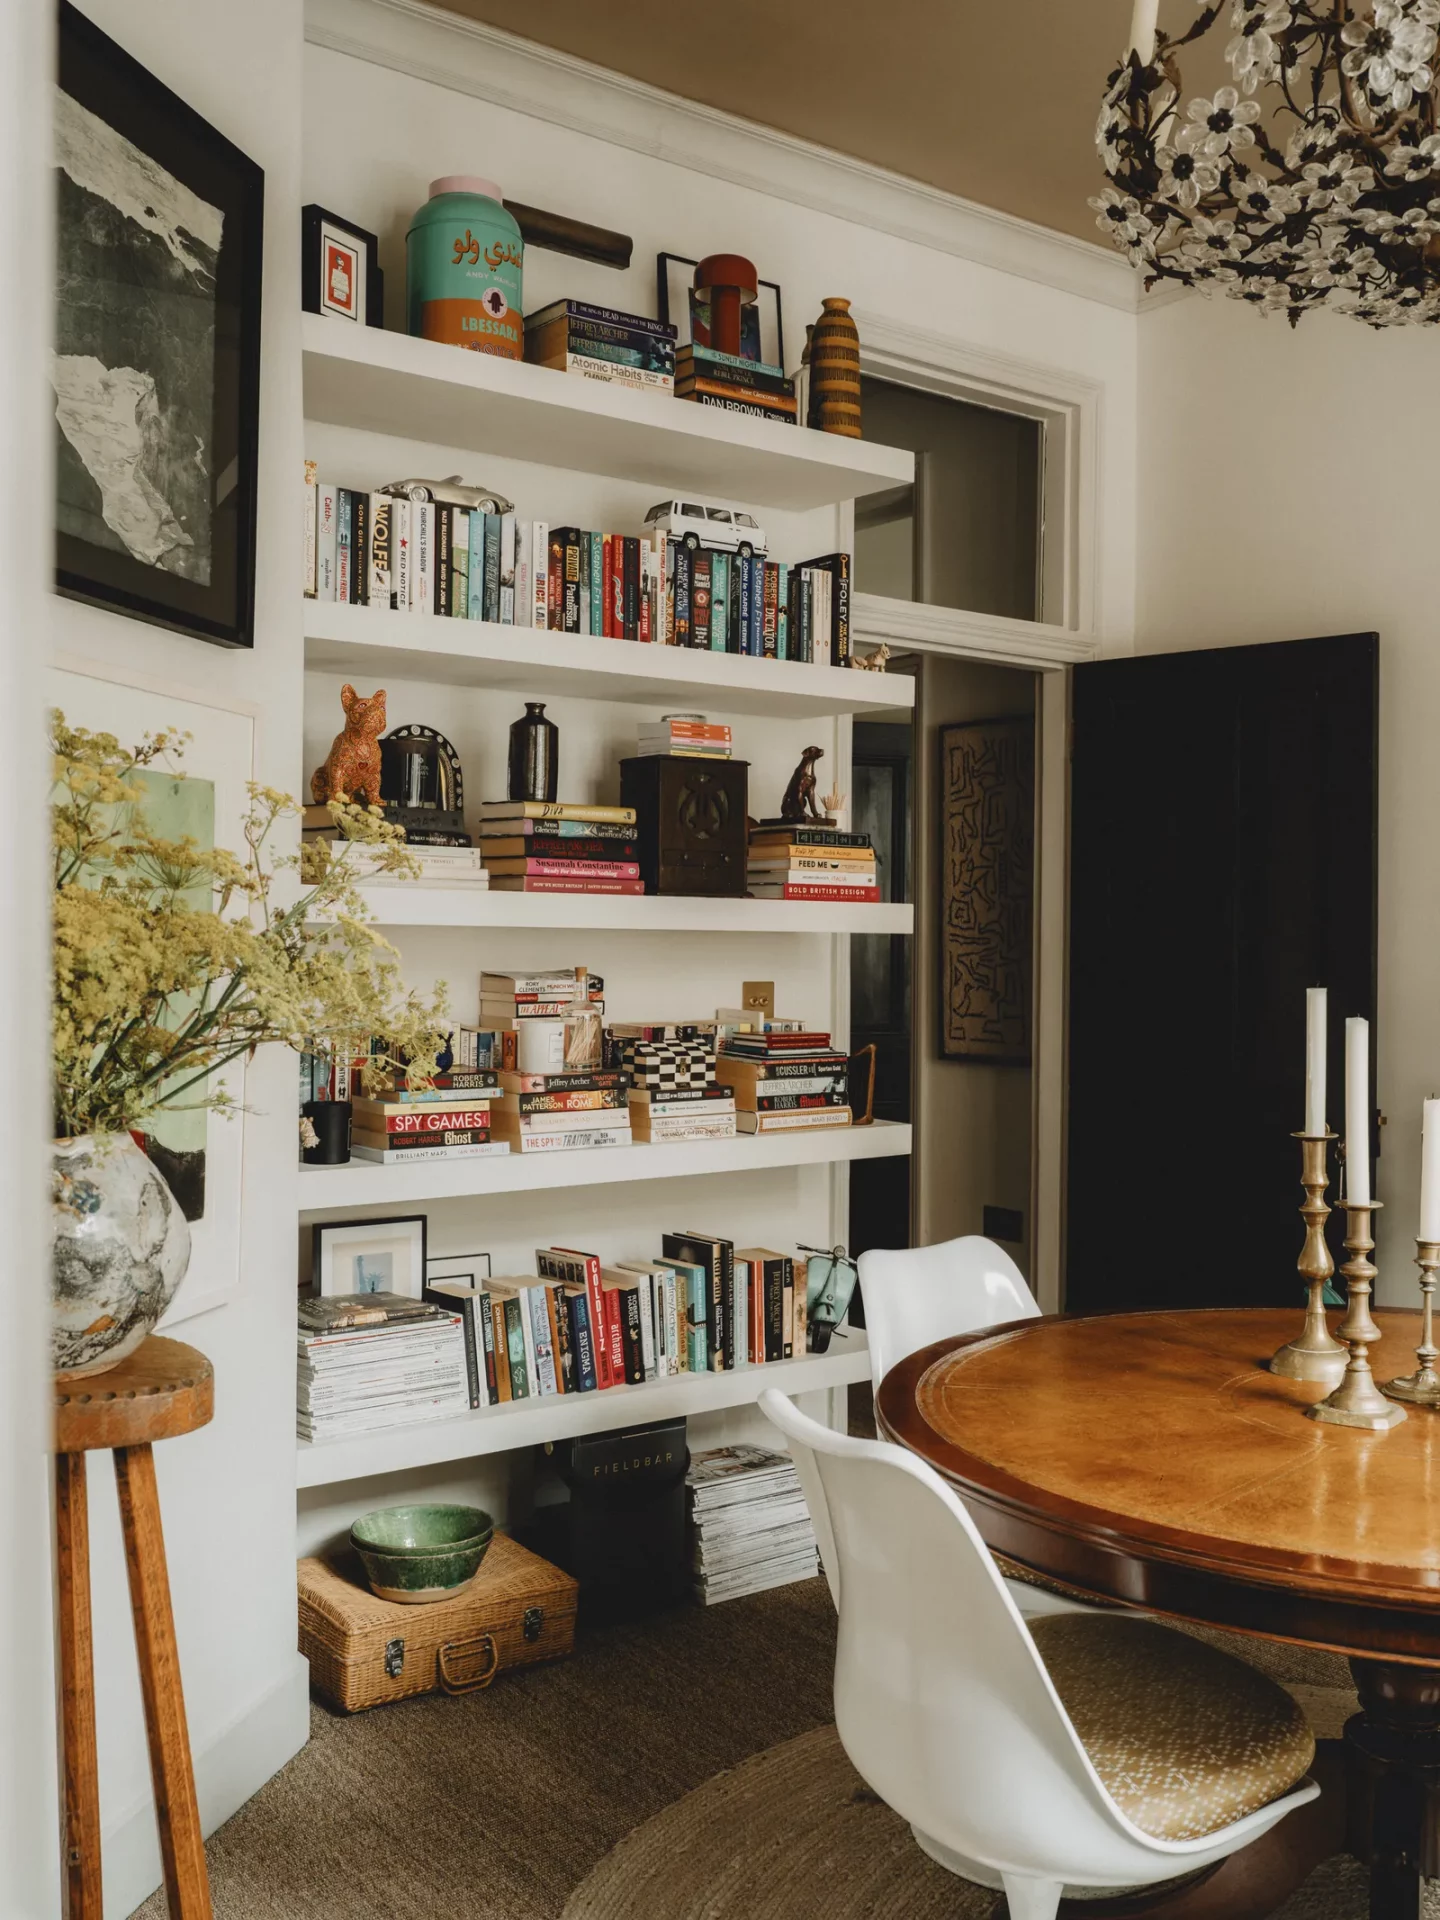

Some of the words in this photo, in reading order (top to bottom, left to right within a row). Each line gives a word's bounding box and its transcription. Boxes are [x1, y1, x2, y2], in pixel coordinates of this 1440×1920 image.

[465, 270, 489, 280] ANDY
[602, 310, 619, 321] DEAD
[461, 317, 518, 342] LBESSARA
[570, 317, 597, 333] JEFFREY
[597, 325, 629, 341] ARCHER
[570, 337, 598, 350] JEFFREY
[571, 355, 609, 373] Atomic
[611, 365, 642, 381] Habits
[718, 354, 738, 364] SUNLIT
[738, 358, 757, 369] NIGHT
[740, 388, 752, 396] Anne
[702, 396, 724, 409] DAN
[726, 401, 765, 418] BROWN
[373, 506, 389, 571] WOLFE
[520, 563, 528, 582] PIECES
[567, 547, 578, 579] PRIVATE
[592, 543, 602, 584] Stephen
[536, 572, 546, 603] BRICK
[593, 586, 601, 604] Fry
[755, 569, 763, 607] Stephen
[763, 569, 771, 603] HARRIS
[566, 583, 576, 627] Patterson
[839, 582, 847, 622] FOLEY
[754, 609, 762, 626] Fry
[717, 612, 726, 645] BROWN
[764, 607, 776, 648] DICTATOR
[535, 859, 576, 869] Susannah
[576, 861, 624, 871] Constantine
[798, 860, 815, 868] FEED
[789, 886, 807, 894] BOLD
[840, 888, 865, 896] DESIGN
[530, 1004, 559, 1014] APPEAL
[452, 1074, 484, 1082] ROBERT
[779, 1064, 808, 1076] CUSSLER
[817, 1065, 833, 1073] Spartan
[547, 1079, 569, 1088] Jeffrey
[763, 1081, 786, 1093] JEFFREY
[788, 1080, 813, 1089] ARCHER
[522, 1101, 564, 1111] PATTERSON
[531, 1095, 555, 1104] JAMES
[566, 1098, 594, 1109] ROME
[799, 1095, 826, 1108] Munich
[395, 1115, 423, 1131] SPY
[427, 1112, 482, 1130] GAMES
[811, 1116, 826, 1124] MARY
[826, 1113, 842, 1123] BEARD
[393, 1137, 417, 1145] ROBERT
[417, 1135, 442, 1144] HARRIS
[444, 1131, 472, 1146] Ghost
[526, 1139, 541, 1148] THE
[540, 1138, 554, 1147] SPY
[562, 1134, 592, 1147] TRAITOR
[395, 1151, 429, 1160] BRILLIANT
[714, 1257, 723, 1300] RuPaul
[772, 1271, 780, 1301] JEFFREY
[666, 1276, 676, 1306] Jeffrey
[482, 1298, 492, 1323] Stella
[591, 1260, 606, 1352] COLDITZ
[535, 1314, 543, 1337] Sword
[669, 1306, 677, 1337] Archer
[773, 1302, 781, 1335] ARCHER
[496, 1324, 504, 1354] GRISHAM
[541, 1324, 549, 1341] than
[677, 1311, 687, 1354] Fatherland
[578, 1330, 590, 1375] ENIGMA
[611, 1323, 624, 1368] archangel
[594, 1452, 673, 1476] FIELDBAR
